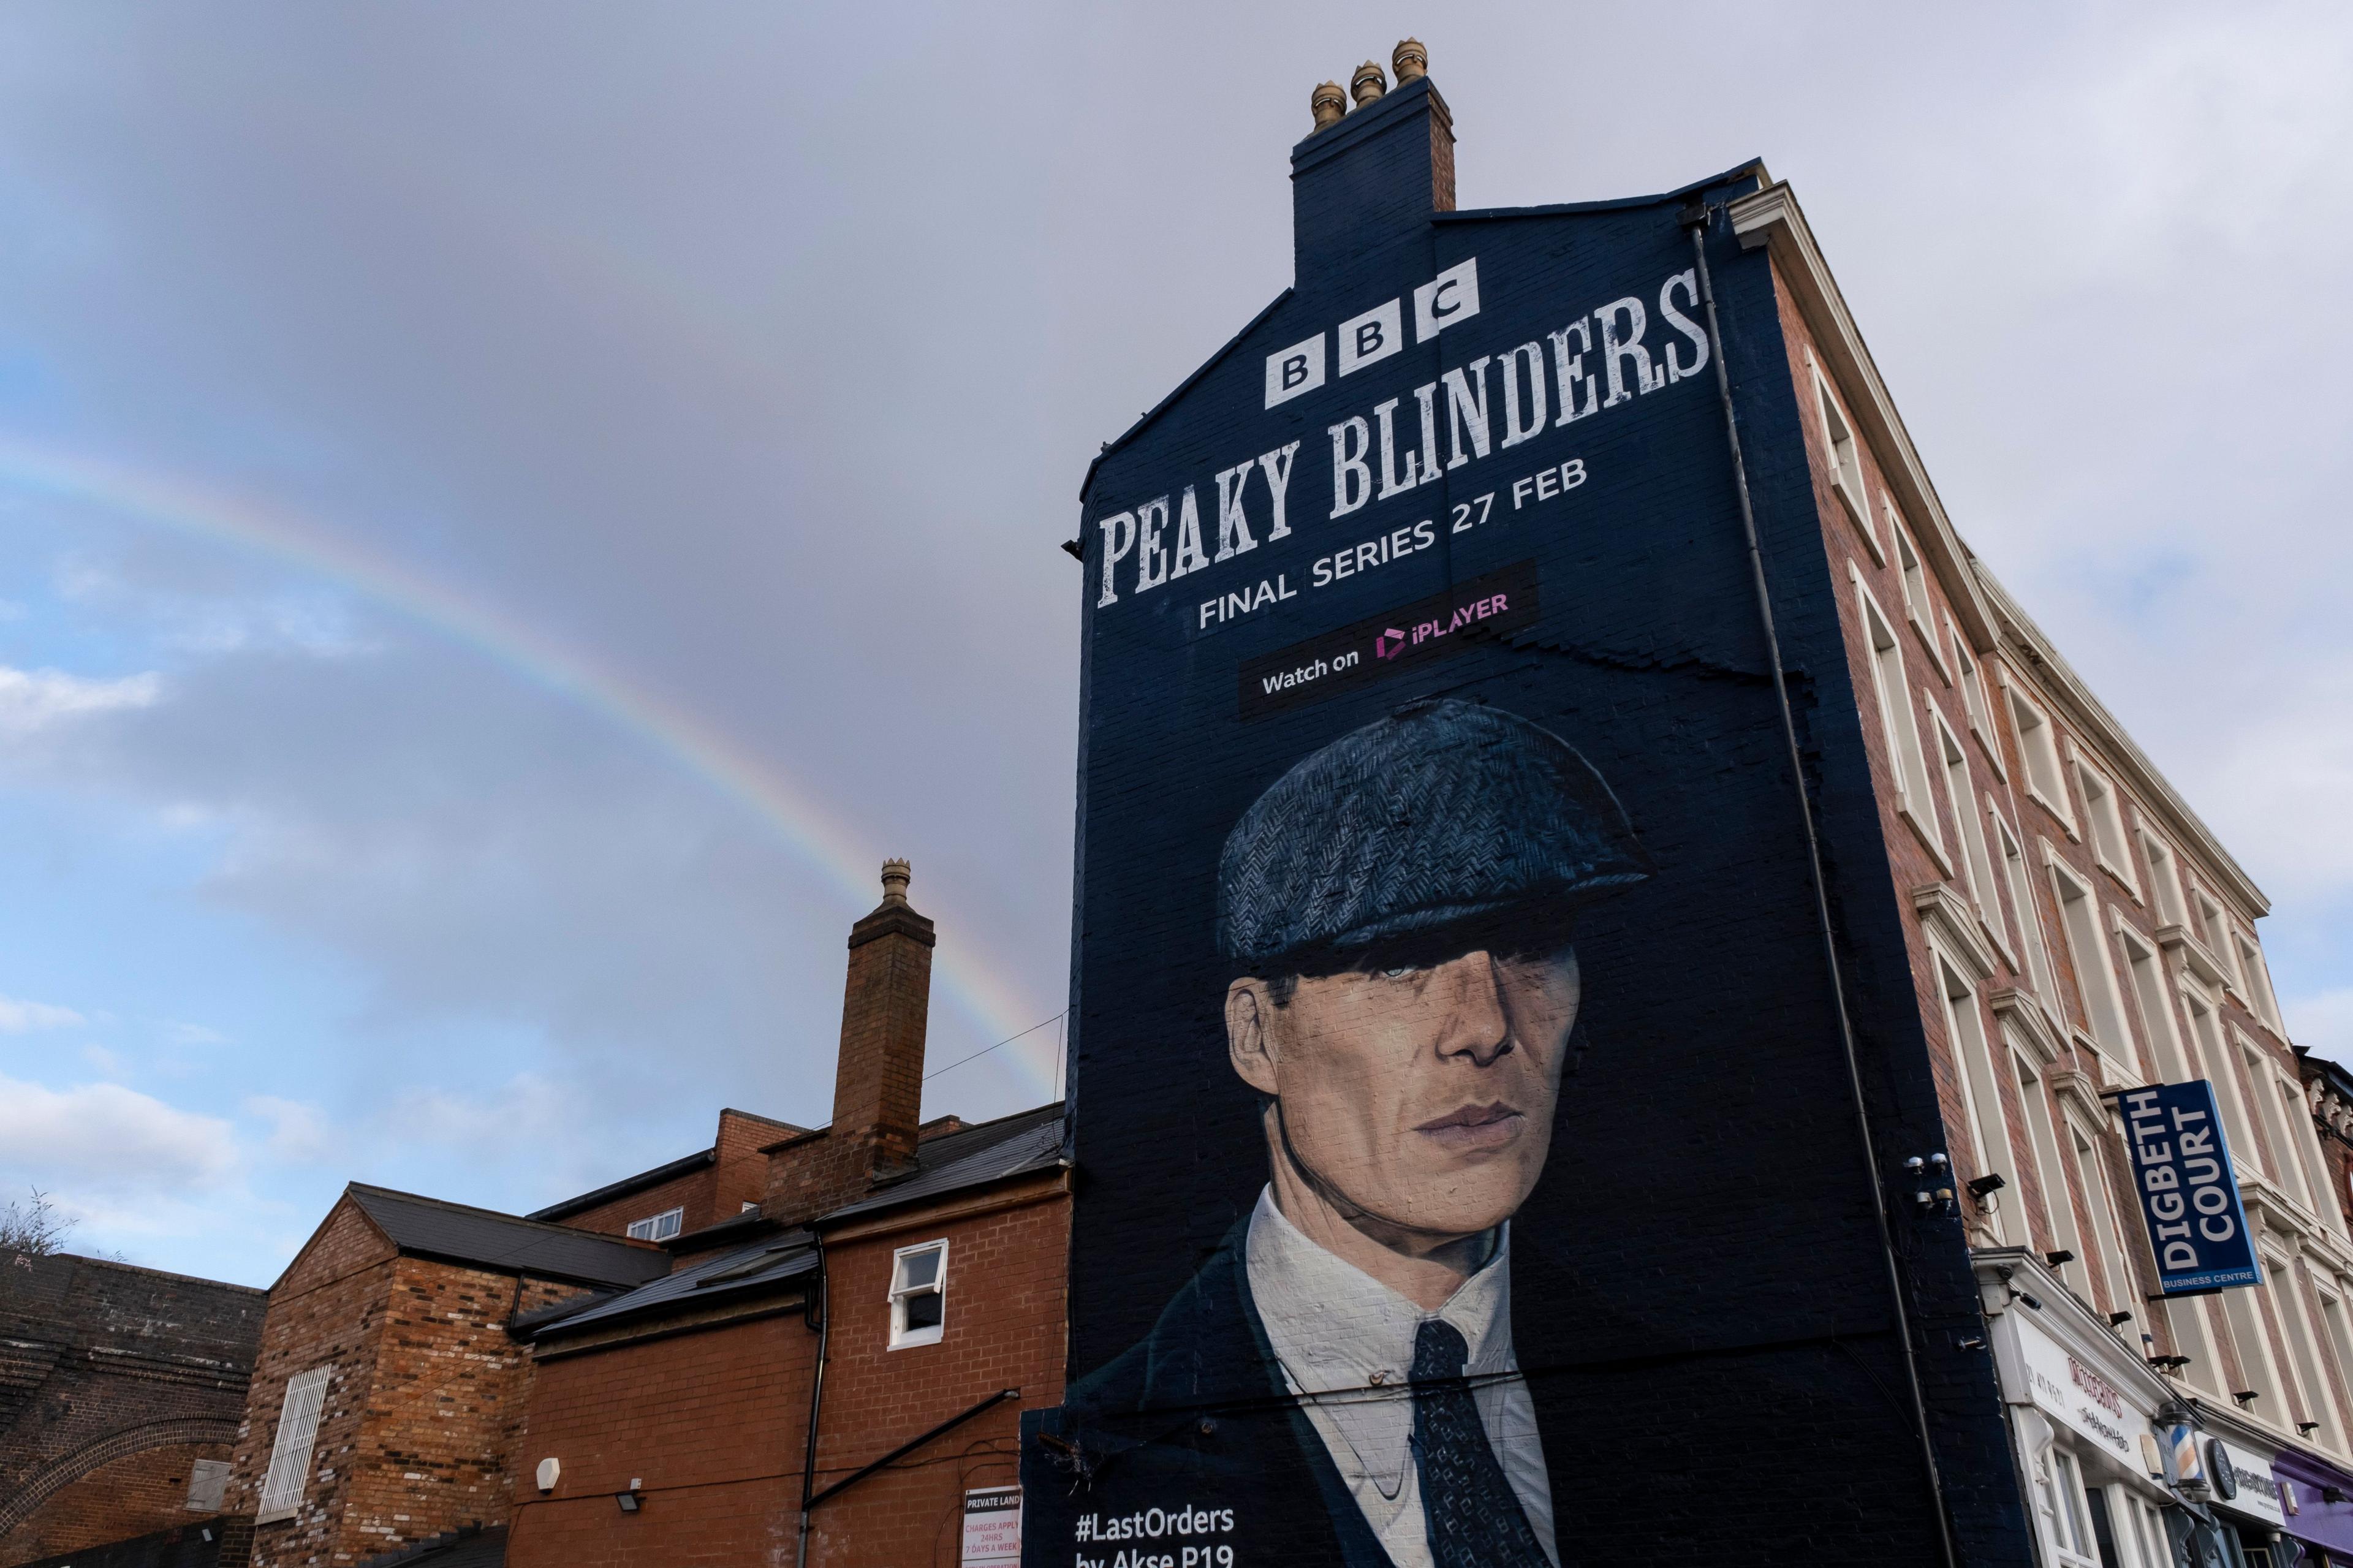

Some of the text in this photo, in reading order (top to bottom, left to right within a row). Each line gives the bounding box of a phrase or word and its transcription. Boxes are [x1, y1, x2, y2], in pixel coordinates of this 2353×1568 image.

[1278, 275, 1464, 395] BBC
[1097, 268, 1709, 609] PEAKY BLINDERS
[1200, 458, 1588, 629] FINAL SERIES 27 FEB
[1262, 593, 1509, 694] Watch on iPLAYER
[2127, 1091, 2199, 1270] DIGBETH
[2172, 1107, 2235, 1242] COURT
[2163, 1271, 2254, 1289] BUSINESS CENTRE
[967, 1495, 1020, 1509] PRIVATE LAND
[965, 1521, 1019, 1533] CHARGES APPLY
[980, 1533, 1003, 1542] 24HRS
[1075, 1504, 1234, 1542] #LastOrders
[971, 1543, 990, 1553] DAYS
[998, 1542, 1017, 1551] WEEK
[1182, 1545, 1234, 1568] P19
